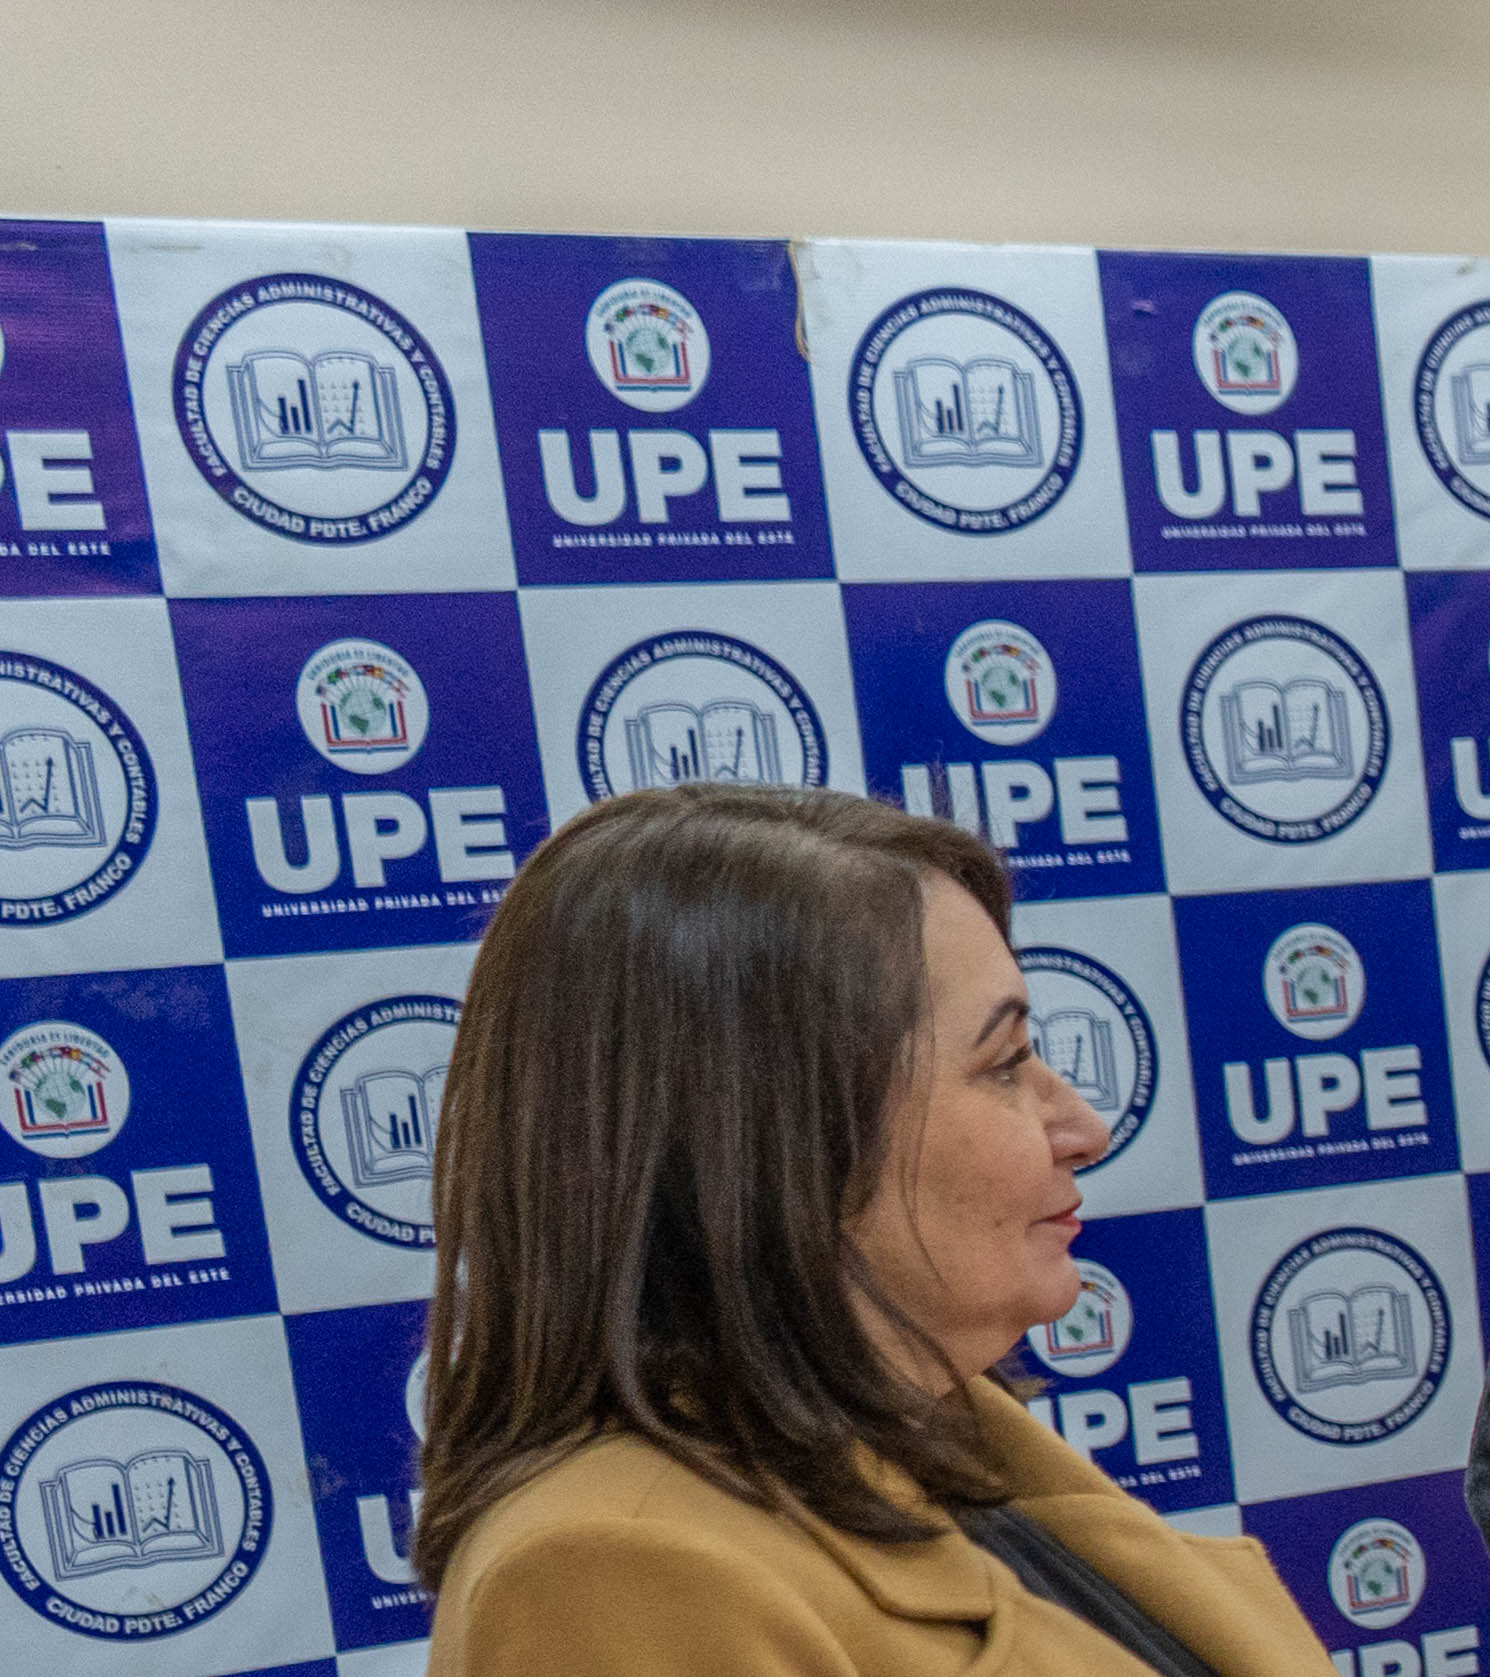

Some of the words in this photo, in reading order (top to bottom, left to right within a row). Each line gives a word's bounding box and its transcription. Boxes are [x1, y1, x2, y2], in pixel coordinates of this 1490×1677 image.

[233, 486, 306, 533] CIUDAD
[369, 476, 433, 531] FRANCO
[537, 427, 792, 526] UPE
[1151, 429, 1364, 519] UPE
[28, 542, 61, 556] DEL
[68, 542, 111, 556] ESTE
[0, 660, 111, 725] ISTRATIVAS
[110, 721, 123, 737] Y
[117, 738, 147, 844] CONTABLES
[245, 784, 516, 895] UPE
[900, 755, 1129, 849] UPE
[64, 852, 132, 911] FRANCO
[261, 899, 369, 917] UNIVERSIDAD
[375, 893, 442, 911] PRIVADA
[446, 891, 475, 905] DEL
[308, 1016, 369, 1082] CIENCIAS
[370, 1002, 463, 1027] ADMINISTR
[1222, 1044, 1429, 1145] UPE
[346, 1201, 415, 1243] CIUDAD
[0, 1286, 68, 1306] RSIDAD
[74, 1277, 145, 1297] PRIVADA
[151, 1272, 183, 1288] DEL
[188, 1267, 232, 1283] ESTE
[4, 1406, 69, 1477] CIENCIAS
[70, 1388, 229, 1440] ADMINISTRATIVAS
[225, 1438, 242, 1453] Y
[234, 1452, 263, 1552] CONTABLES
[45, 1597, 120, 1634] CIUDAD
[124, 1612, 183, 1635] PDTE.
[183, 1560, 249, 1622] FRANCO
